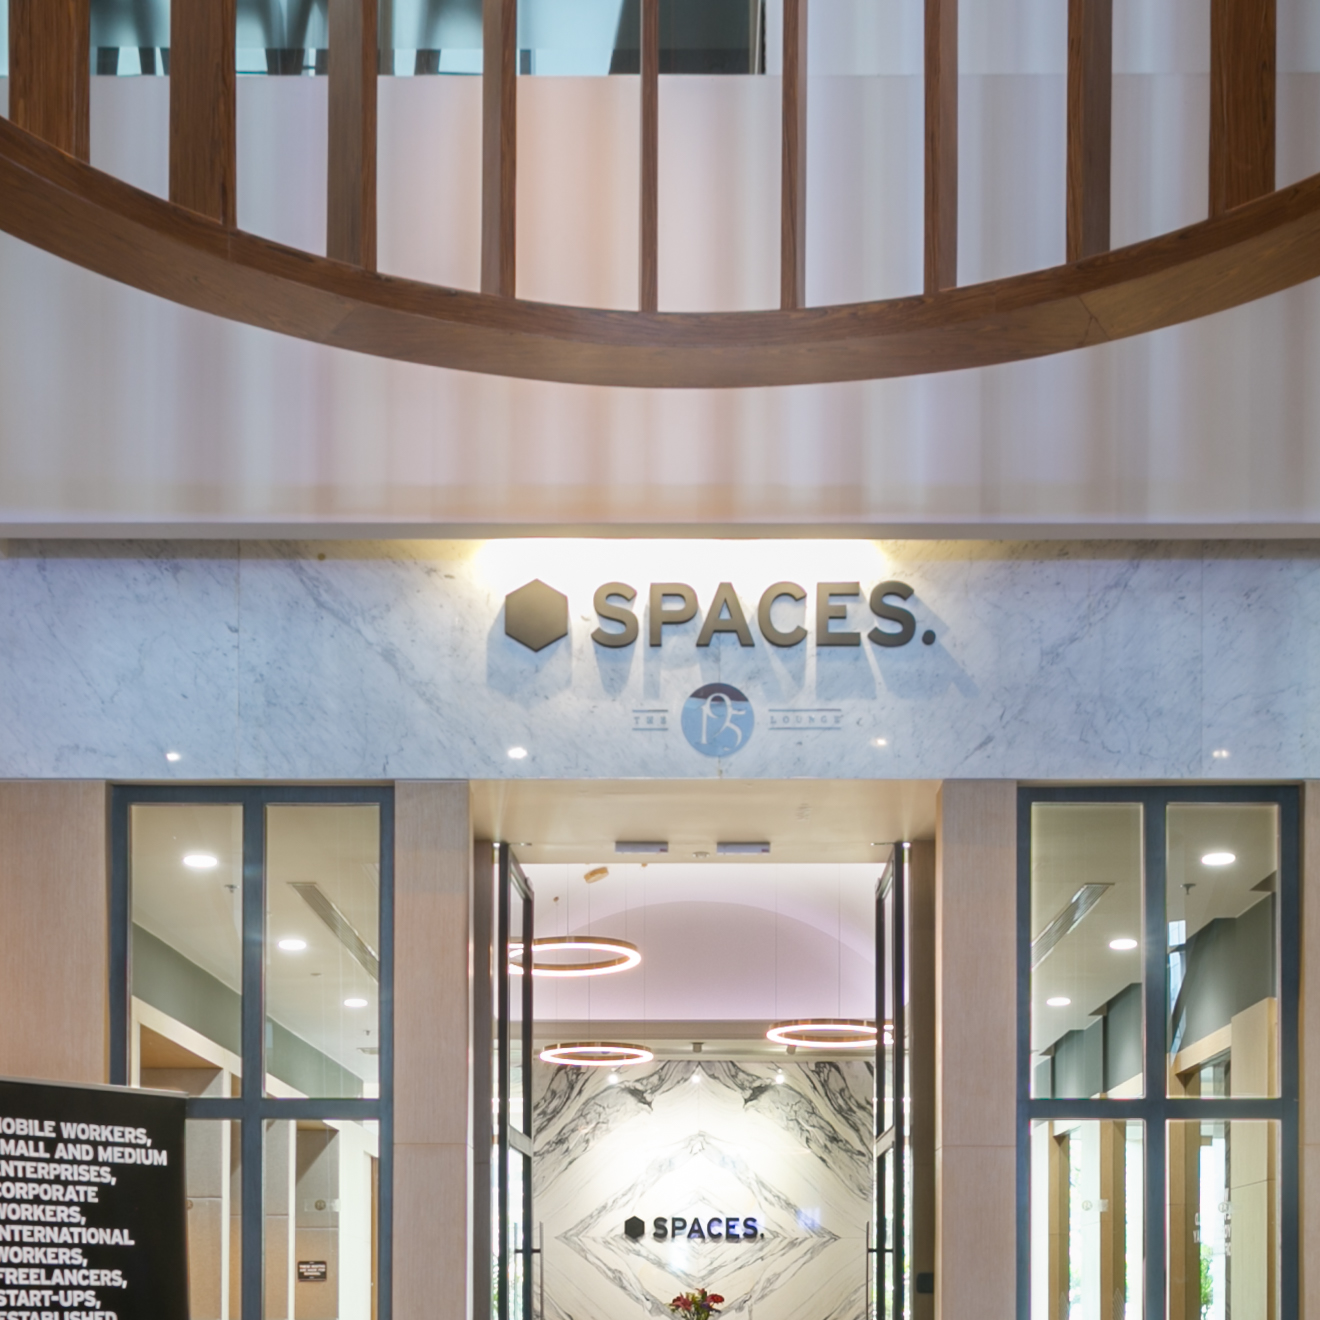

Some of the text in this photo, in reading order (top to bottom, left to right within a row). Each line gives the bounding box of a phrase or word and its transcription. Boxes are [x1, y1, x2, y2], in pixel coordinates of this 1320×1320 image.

[591, 580, 936, 648] SPACES.
[770, 715, 842, 726] LOUNGE
[60, 1122, 152, 1147] WORKERS,
[54, 1143, 94, 1162] AND
[97, 1147, 168, 1166] MEDIUM
[653, 1217, 765, 1239] SPACES.
